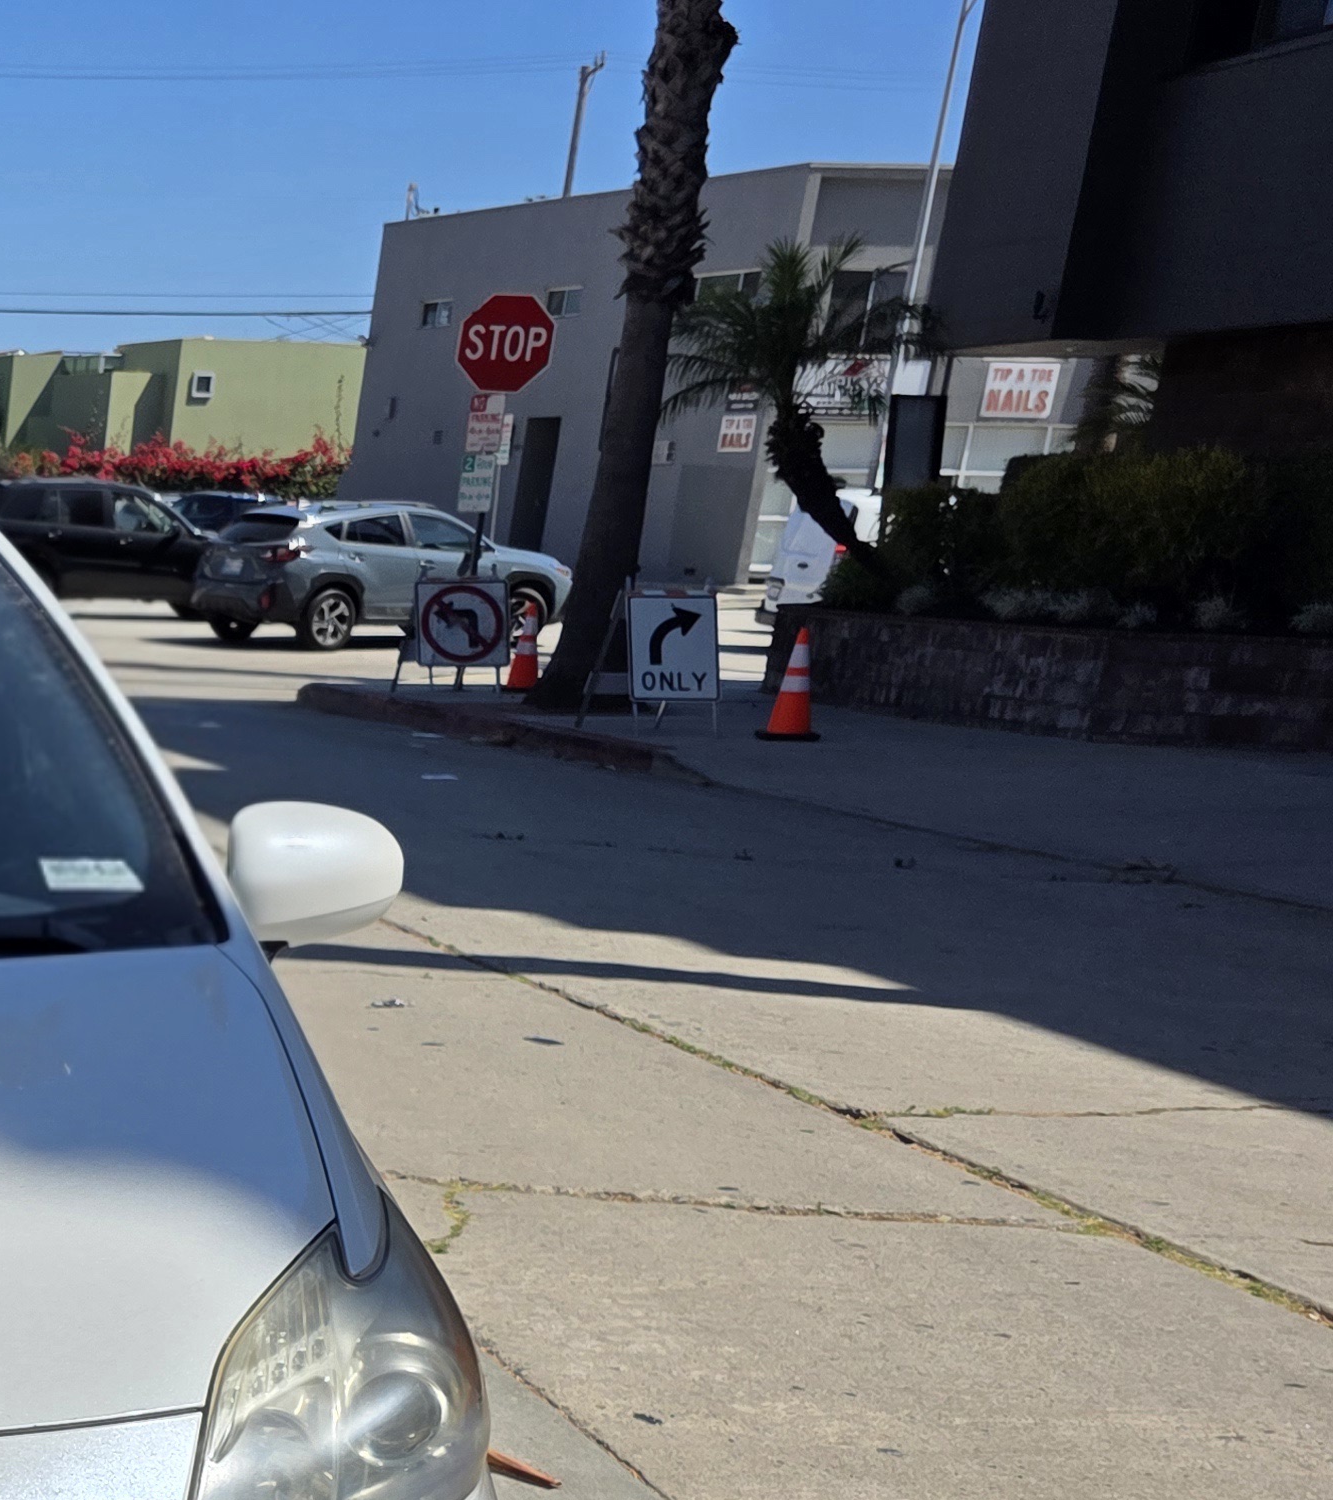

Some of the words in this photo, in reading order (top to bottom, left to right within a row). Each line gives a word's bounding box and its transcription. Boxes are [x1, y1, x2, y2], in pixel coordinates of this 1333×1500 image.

[465, 323, 548, 363] STOP
[984, 388, 1050, 414] NAILS
[641, 671, 707, 692] ONLY
